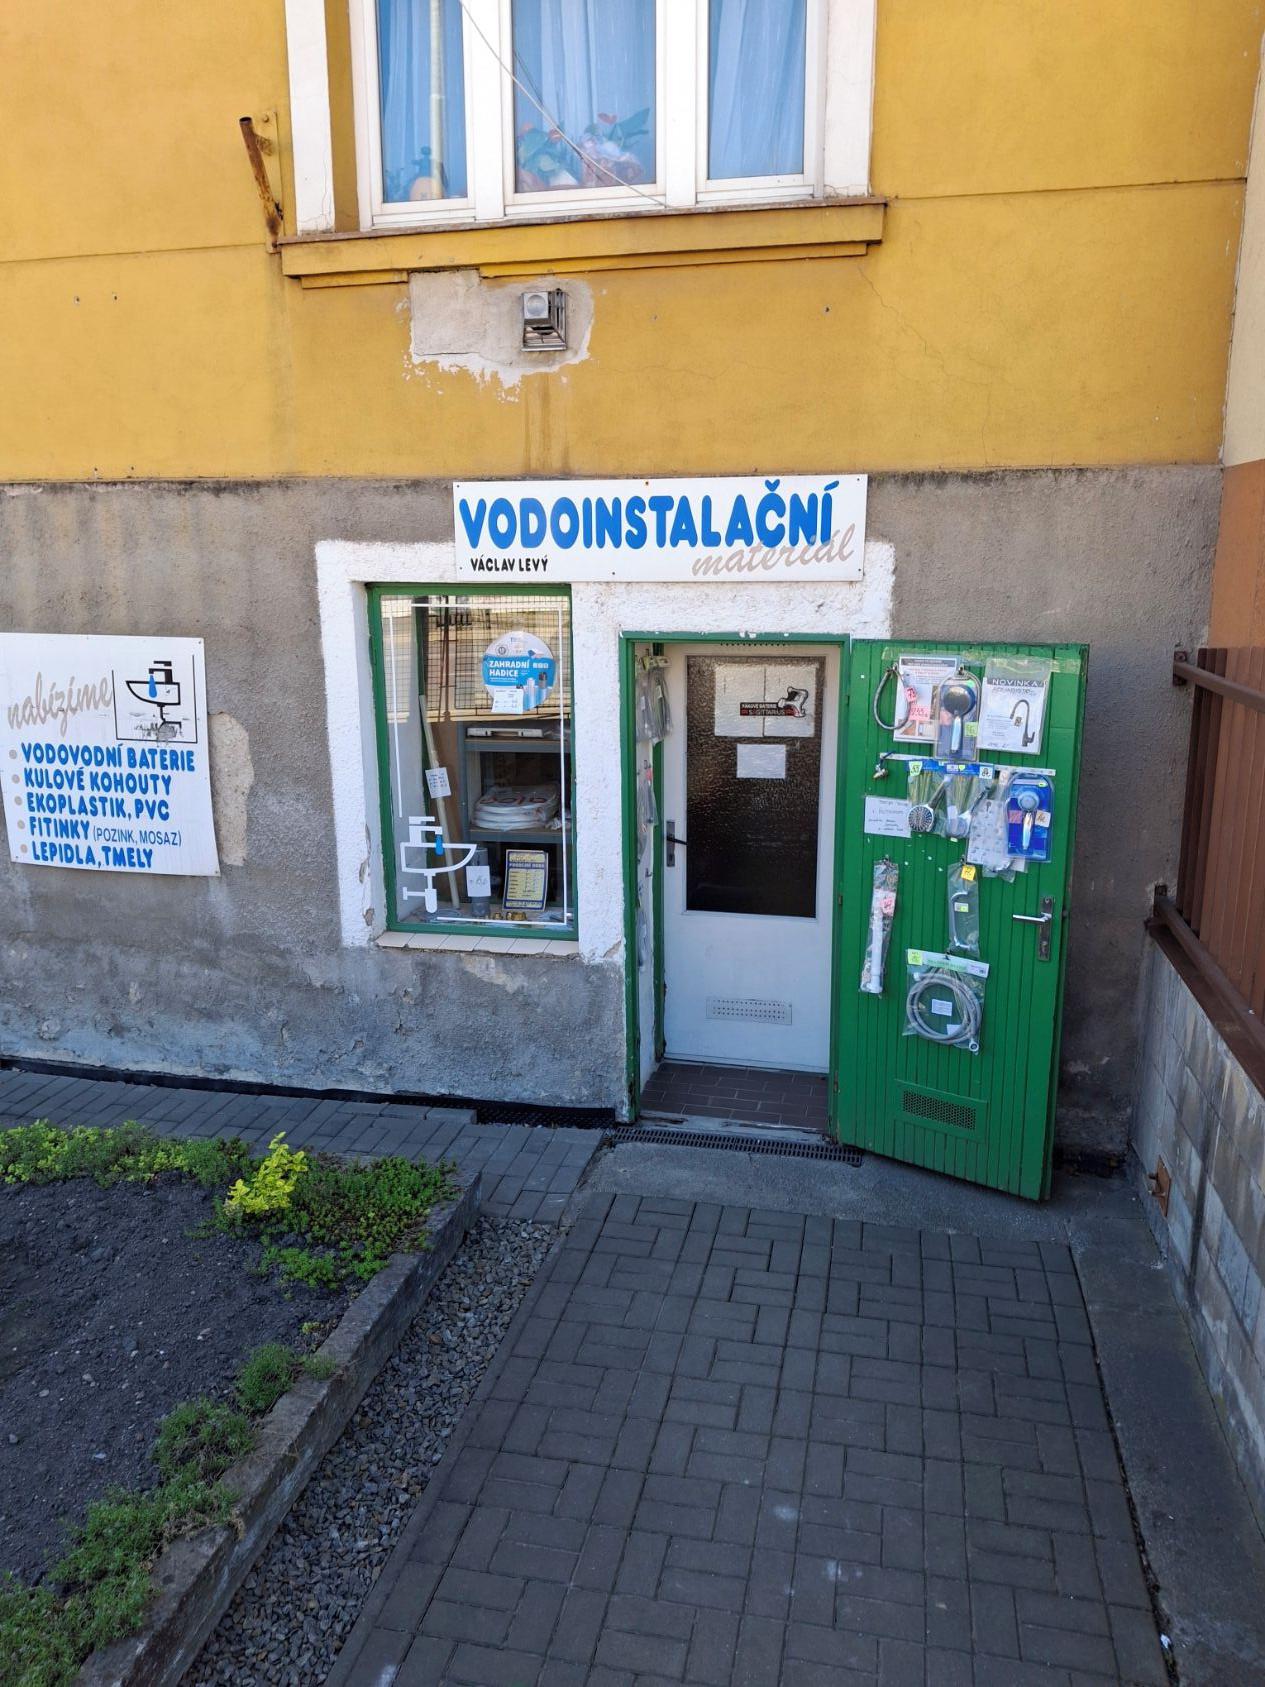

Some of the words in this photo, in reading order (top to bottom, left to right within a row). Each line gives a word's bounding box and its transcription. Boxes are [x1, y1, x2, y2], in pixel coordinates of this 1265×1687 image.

[459, 479, 839, 549] VODOINSTALAČNÍ
[470, 554, 516, 572] VÁCLAV
[518, 553, 548, 572] LEVÝ
[692, 523, 856, 576] materiál
[489, 659, 530, 669] ZAHRADNÍ
[489, 669, 519, 677] HADICE
[992, 679, 1038, 688] NOVINKA
[8, 671, 113, 737] nabízíme
[21, 742, 123, 767] VODOVODNÍ
[127, 747, 195, 772] BATERIE
[23, 767, 85, 791] KULOVÉ
[90, 771, 172, 795] KOHOUTY
[27, 792, 132, 821] EKOPLASTIK,
[135, 799, 169, 821] PVC
[29, 816, 90, 840] FITINKY
[93, 826, 138, 845] (POZINK,
[140, 830, 182, 847] MOSAZ)
